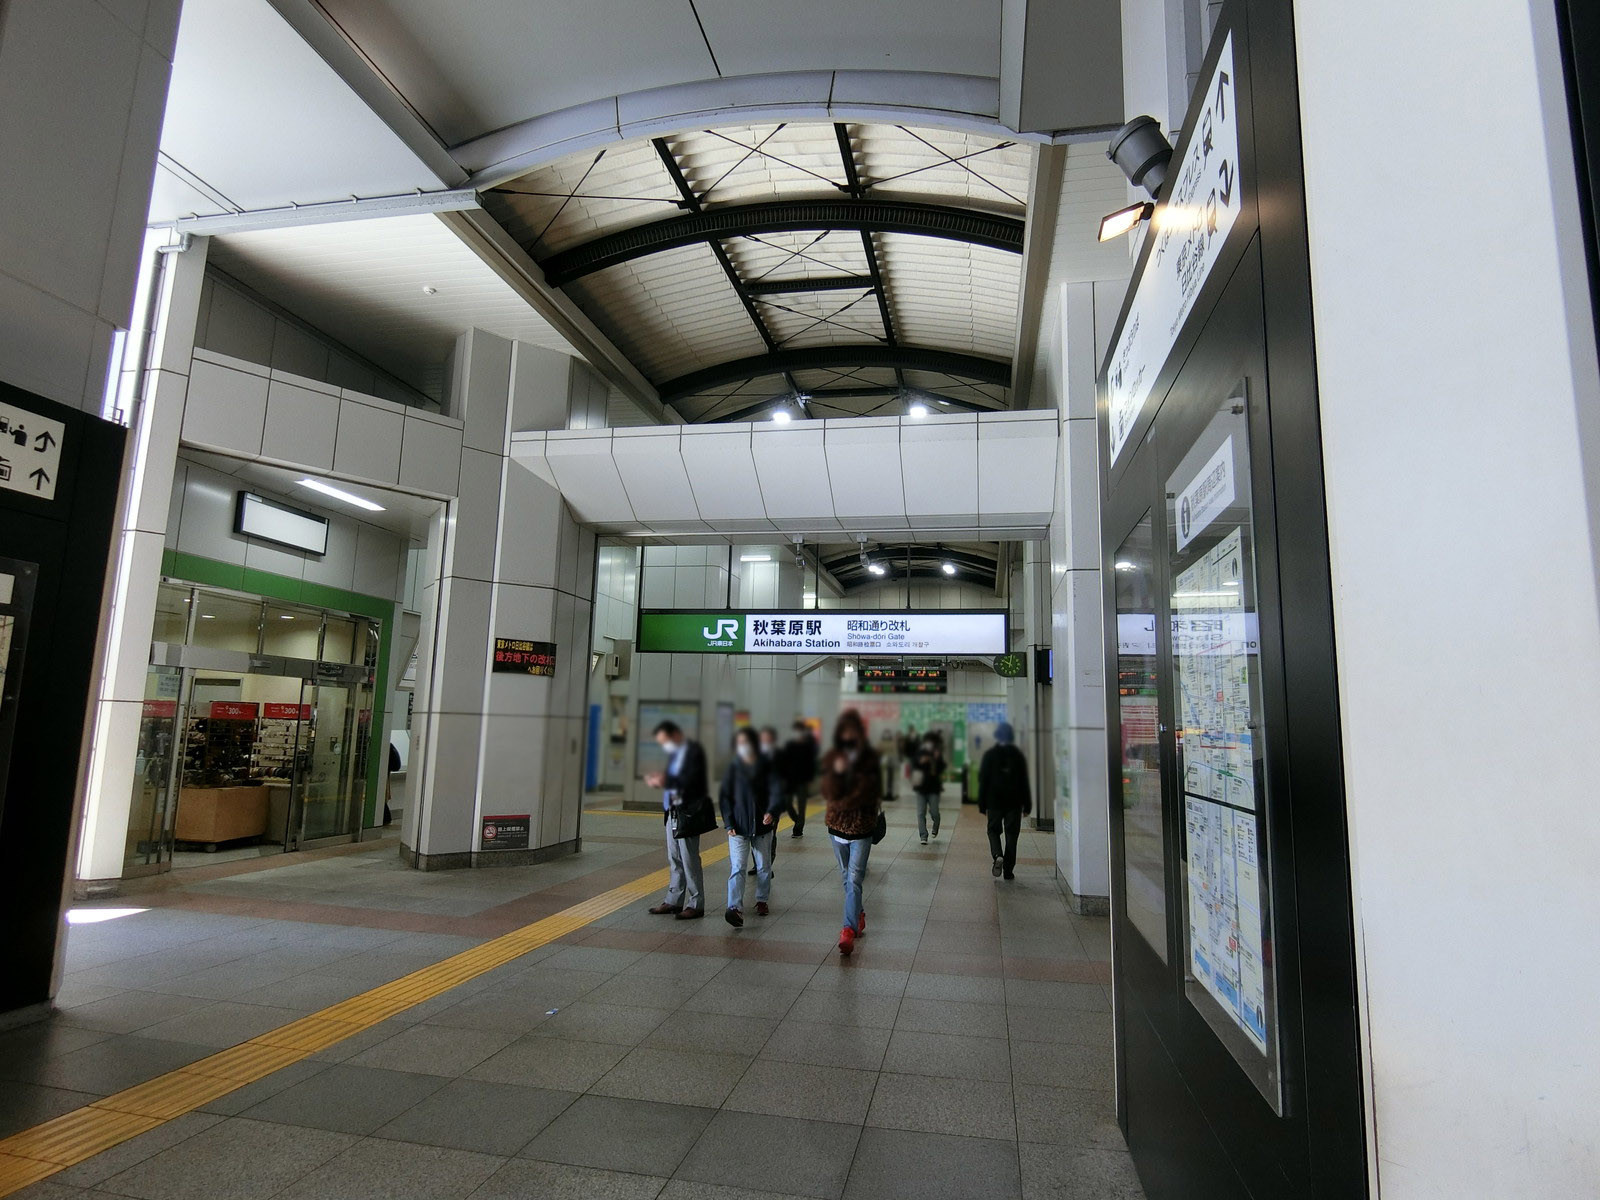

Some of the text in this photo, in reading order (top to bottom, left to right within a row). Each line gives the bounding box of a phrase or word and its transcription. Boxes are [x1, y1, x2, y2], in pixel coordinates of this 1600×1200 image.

[1181, 233, 1204, 297] 日比谷線
[703, 619, 739, 640] JR
[753, 620, 822, 636] 秋葉原駅
[847, 620, 910, 632] 昭和通り改札
[753, 638, 840, 648] Akihabara Station
